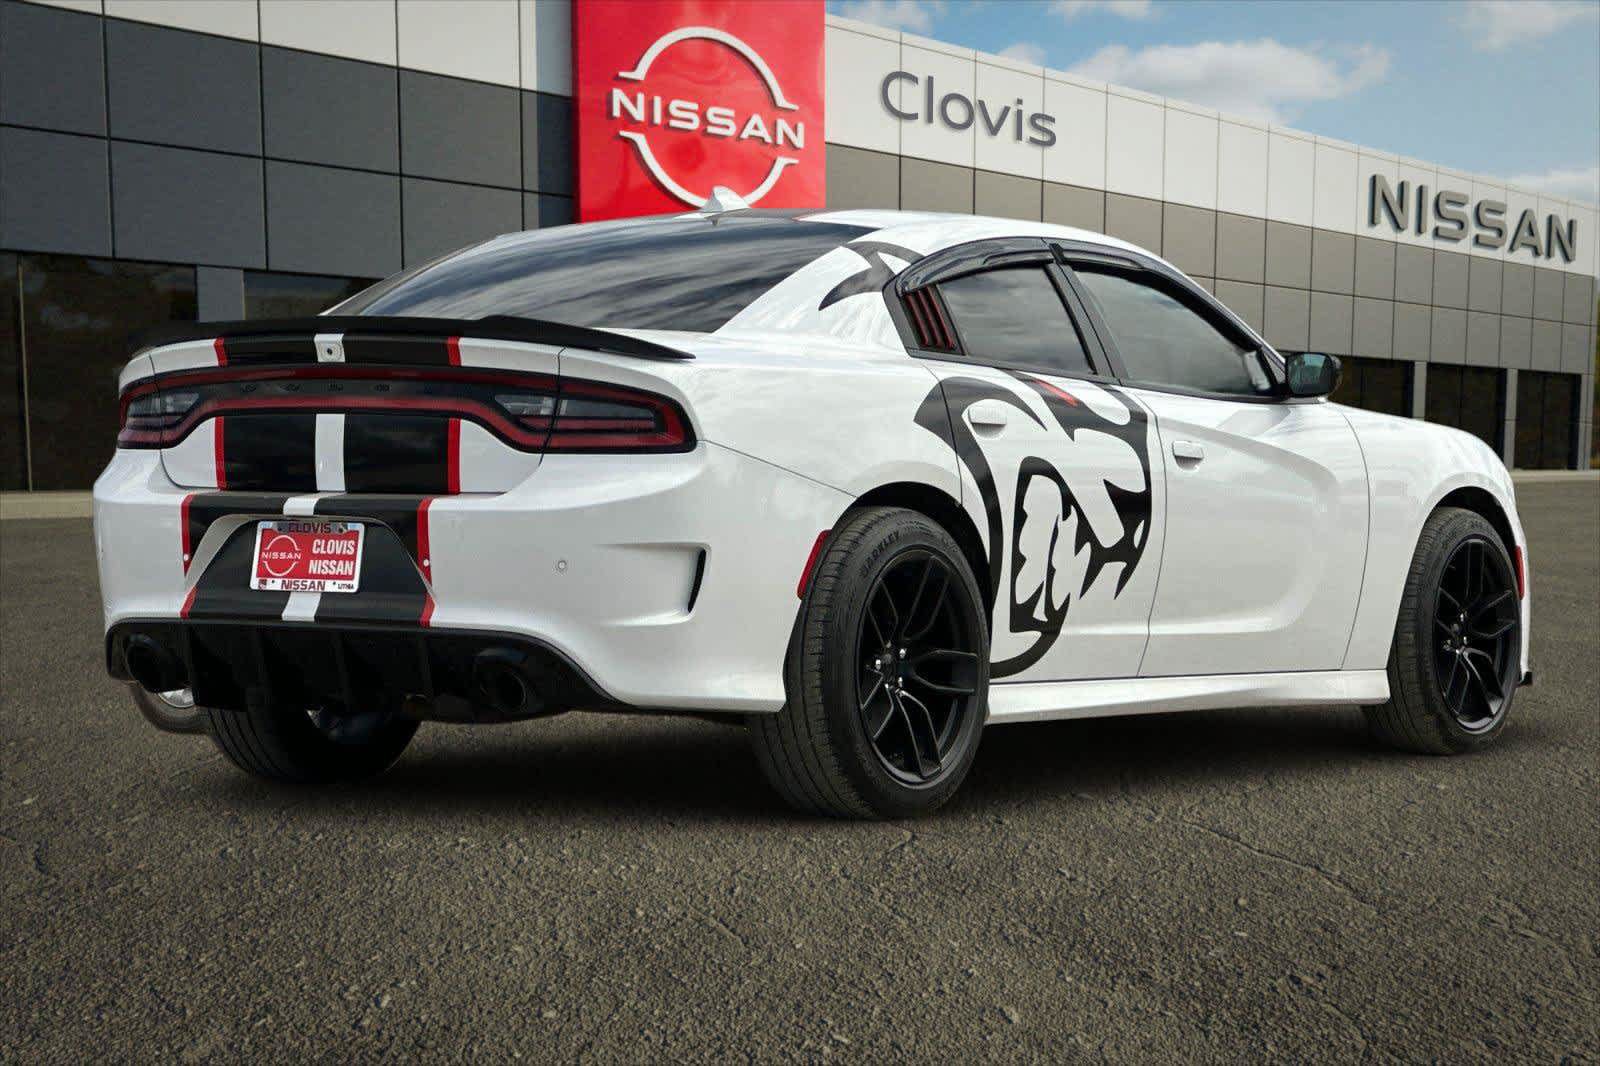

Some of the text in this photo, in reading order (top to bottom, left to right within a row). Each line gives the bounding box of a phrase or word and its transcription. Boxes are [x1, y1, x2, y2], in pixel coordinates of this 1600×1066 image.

[881, 71, 1057, 147] Clovis
[610, 87, 805, 149] NISSAN
[1368, 173, 1578, 263] NISSAN
[289, 522, 331, 533] CLOVIS
[312, 539, 356, 555] CLOVIS
[261, 551, 301, 560] NISSAN
[308, 559, 353, 576] NISSAN
[281, 579, 326, 591] NISSAN
